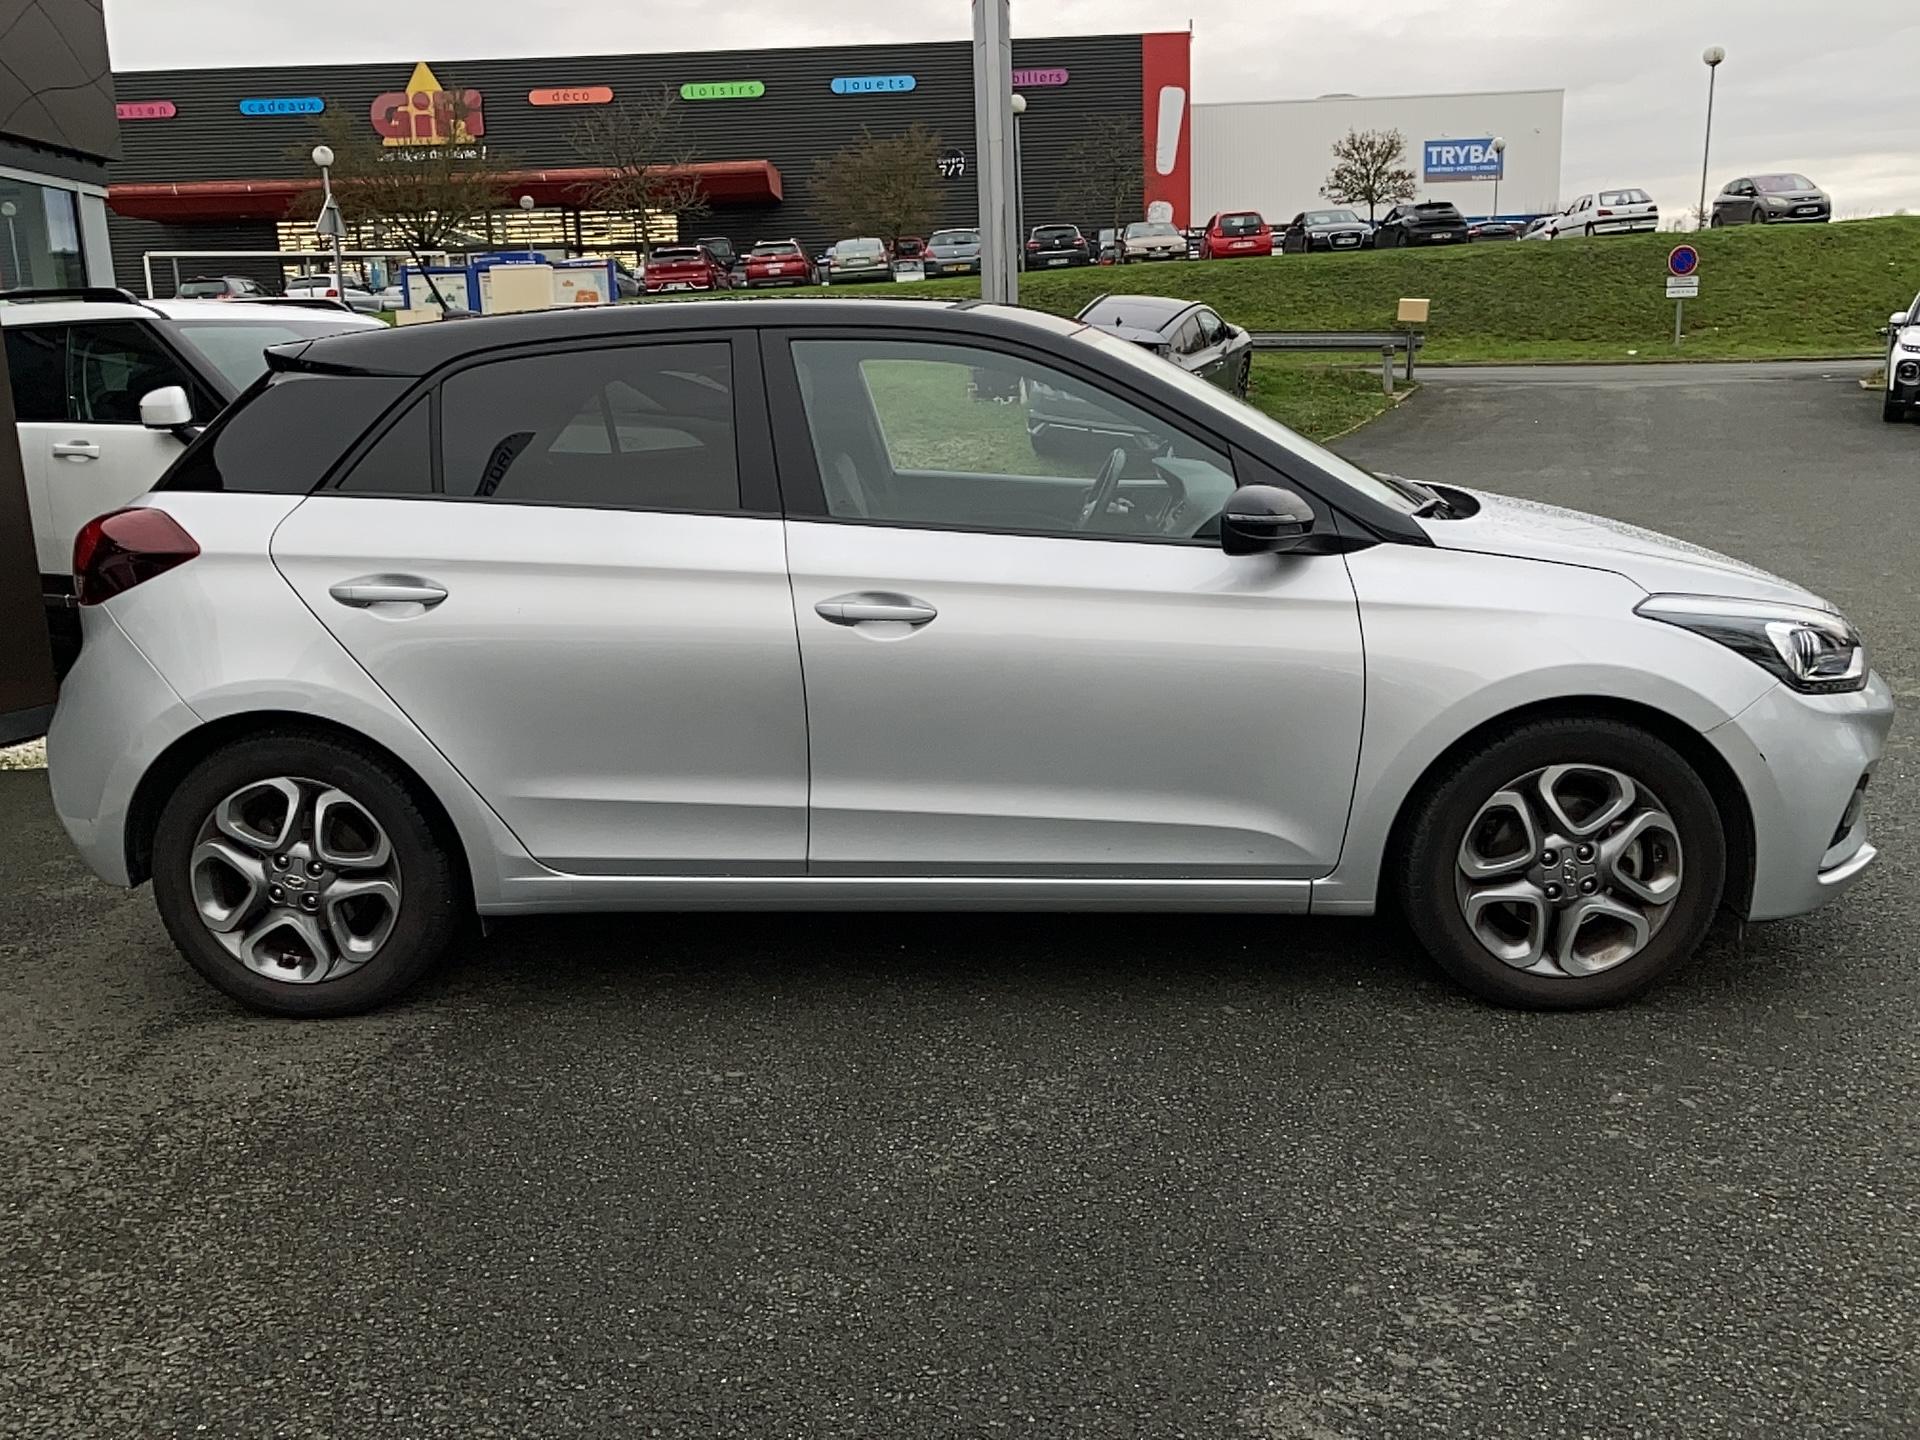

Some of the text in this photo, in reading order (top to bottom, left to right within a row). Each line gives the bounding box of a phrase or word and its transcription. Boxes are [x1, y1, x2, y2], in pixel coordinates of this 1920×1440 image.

[689, 84, 755, 97] loisirs
[842, 79, 905, 94] jouets
[551, 88, 590, 102] déco
[247, 101, 316, 113] cadeaux
[1427, 143, 1498, 165] TRYBA
[938, 164, 965, 176] 7/7
